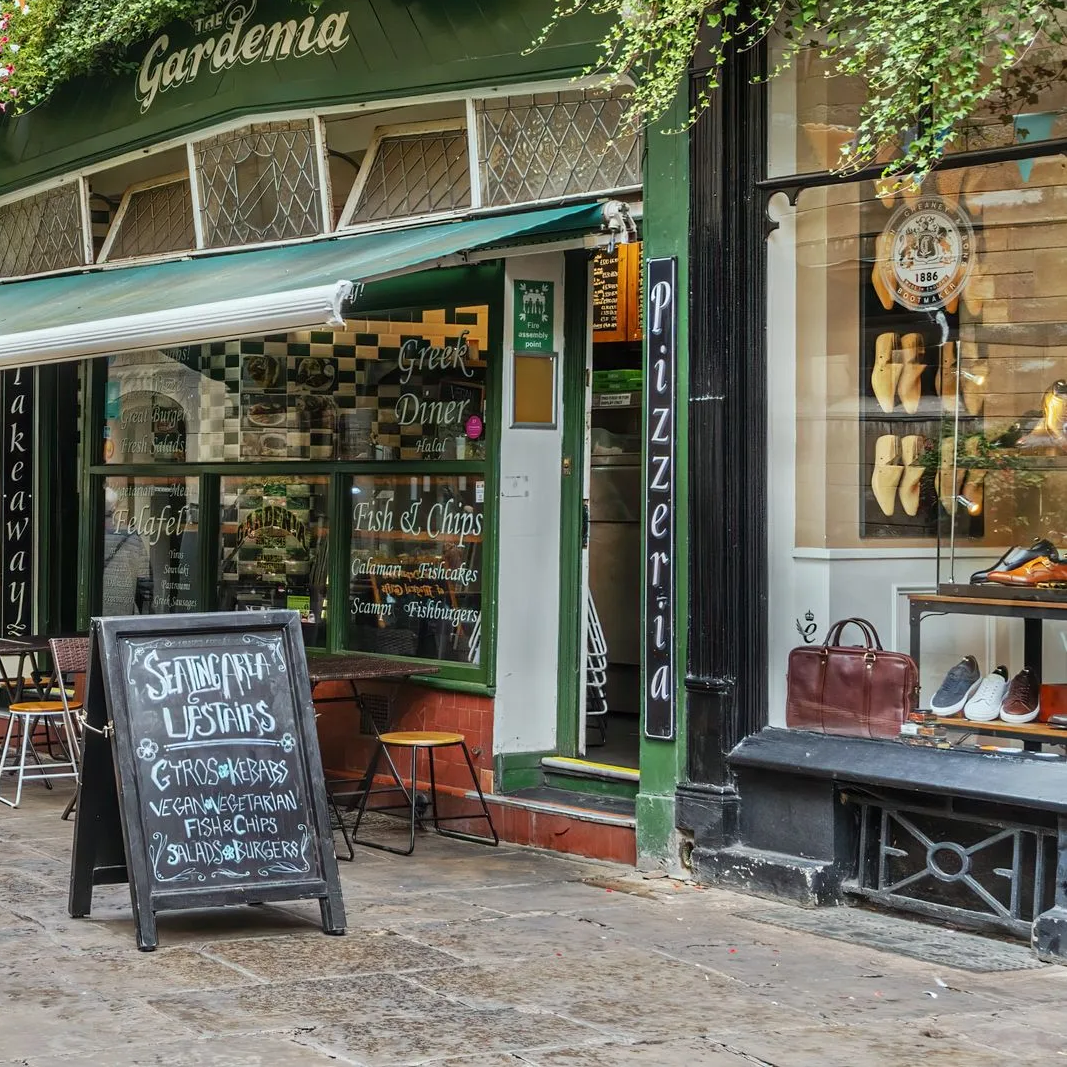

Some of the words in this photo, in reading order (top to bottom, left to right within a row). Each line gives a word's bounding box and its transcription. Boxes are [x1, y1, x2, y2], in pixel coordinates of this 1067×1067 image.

[191, 14, 224, 34] THE
[915, 272, 939, 283] 1886
[518, 332, 549, 341] assembly
[398, 330, 474, 384] Greek
[121, 408, 147, 430] Great
[395, 390, 471, 426] Diner
[121, 435, 147, 454] Fresh
[415, 437, 447, 453] Halal
[650, 280, 671, 702] Pizzeria
[113, 505, 189, 546] Felafel
[353, 498, 394, 531] Fish
[427, 498, 484, 548] Chips
[351, 557, 403, 577] Calamari
[418, 561, 479, 587] Fishcakes
[350, 597, 392, 622] Scampi
[407, 600, 479, 628] Fishburgers
[144, 648, 223, 704] SEATING
[222, 651, 271, 699] AREA
[162, 700, 277, 740] UPSTAIRS
[150, 758, 220, 792] GYROS
[229, 757, 288, 788] KEBABS
[149, 795, 206, 818] VEGAN
[212, 789, 298, 816] VEGETARIAN
[167, 840, 224, 867] SALADS
[232, 838, 299, 863] BURGERS
